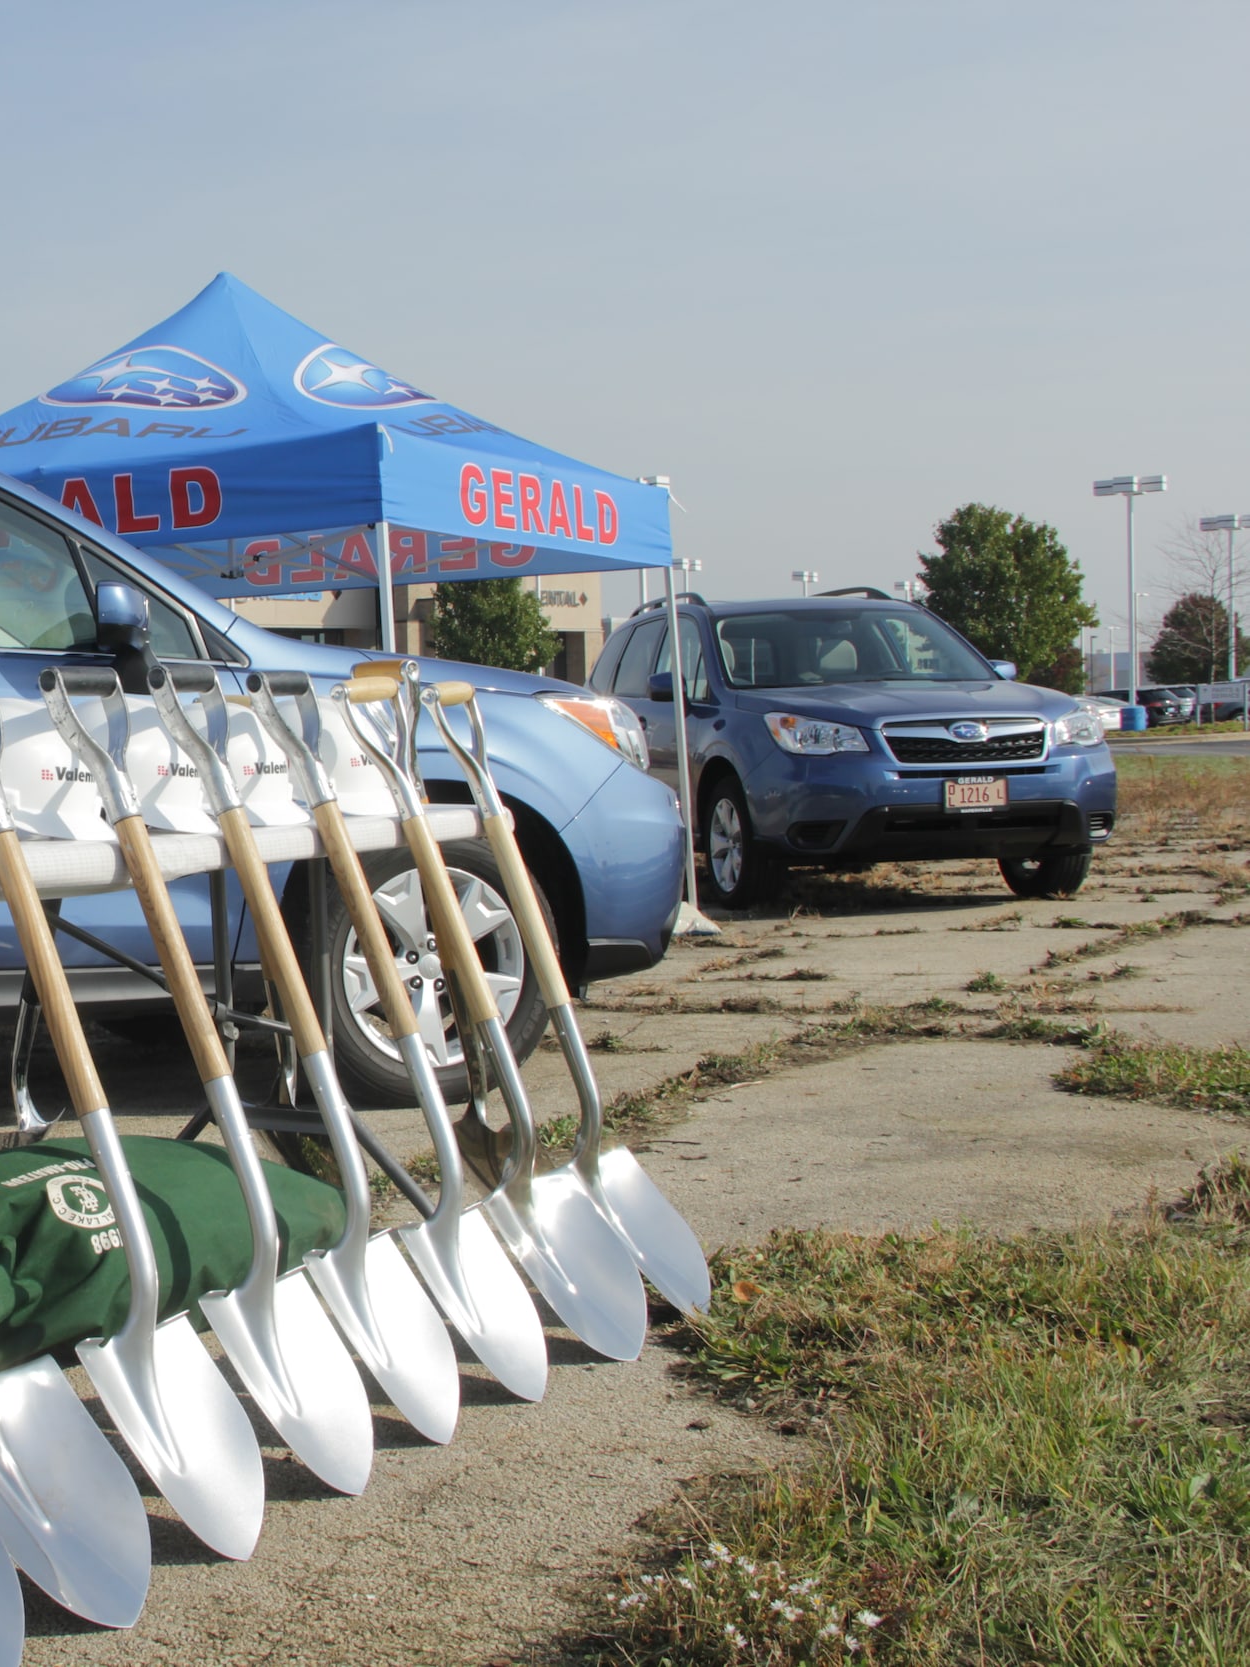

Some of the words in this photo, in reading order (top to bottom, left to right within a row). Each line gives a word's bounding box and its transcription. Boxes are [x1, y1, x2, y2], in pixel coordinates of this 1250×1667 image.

[60, 465, 223, 535] ALD
[459, 462, 619, 546] GERALD
[958, 776, 994, 785] GERALD
[960, 786, 990, 804] 1216
